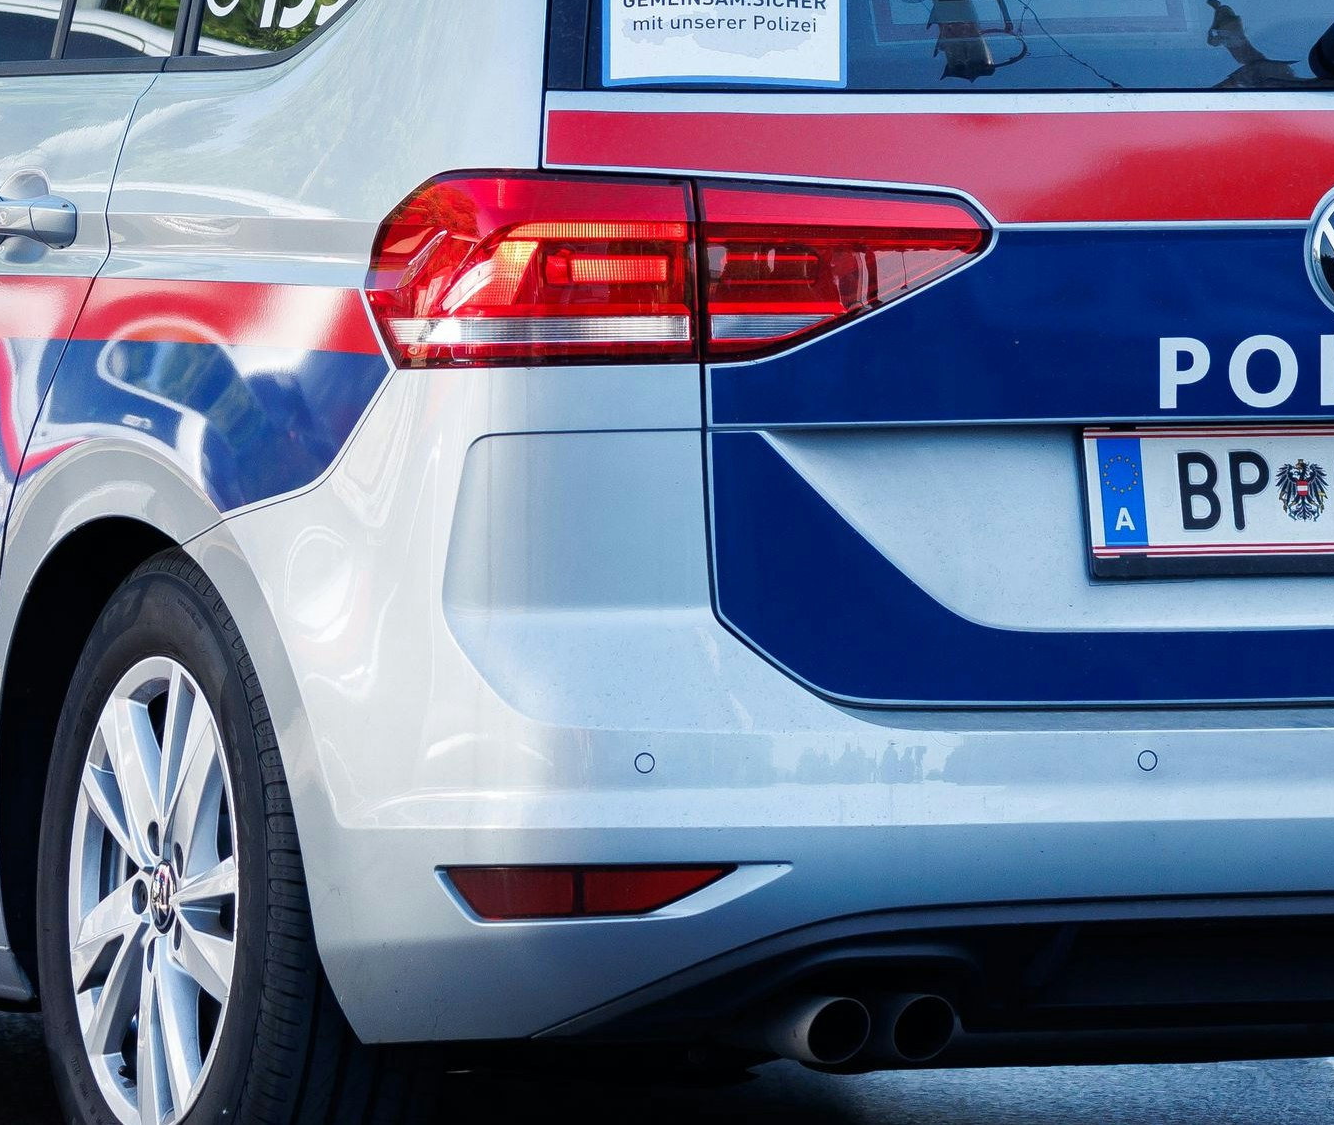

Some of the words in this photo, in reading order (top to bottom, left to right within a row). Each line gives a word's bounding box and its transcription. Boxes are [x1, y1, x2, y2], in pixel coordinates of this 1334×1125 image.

[632, 15, 665, 32] mit
[670, 15, 748, 30] unserer
[753, 15, 818, 33] Polizei
[1176, 448, 1269, 532] BP
[1114, 506, 1137, 531] A
